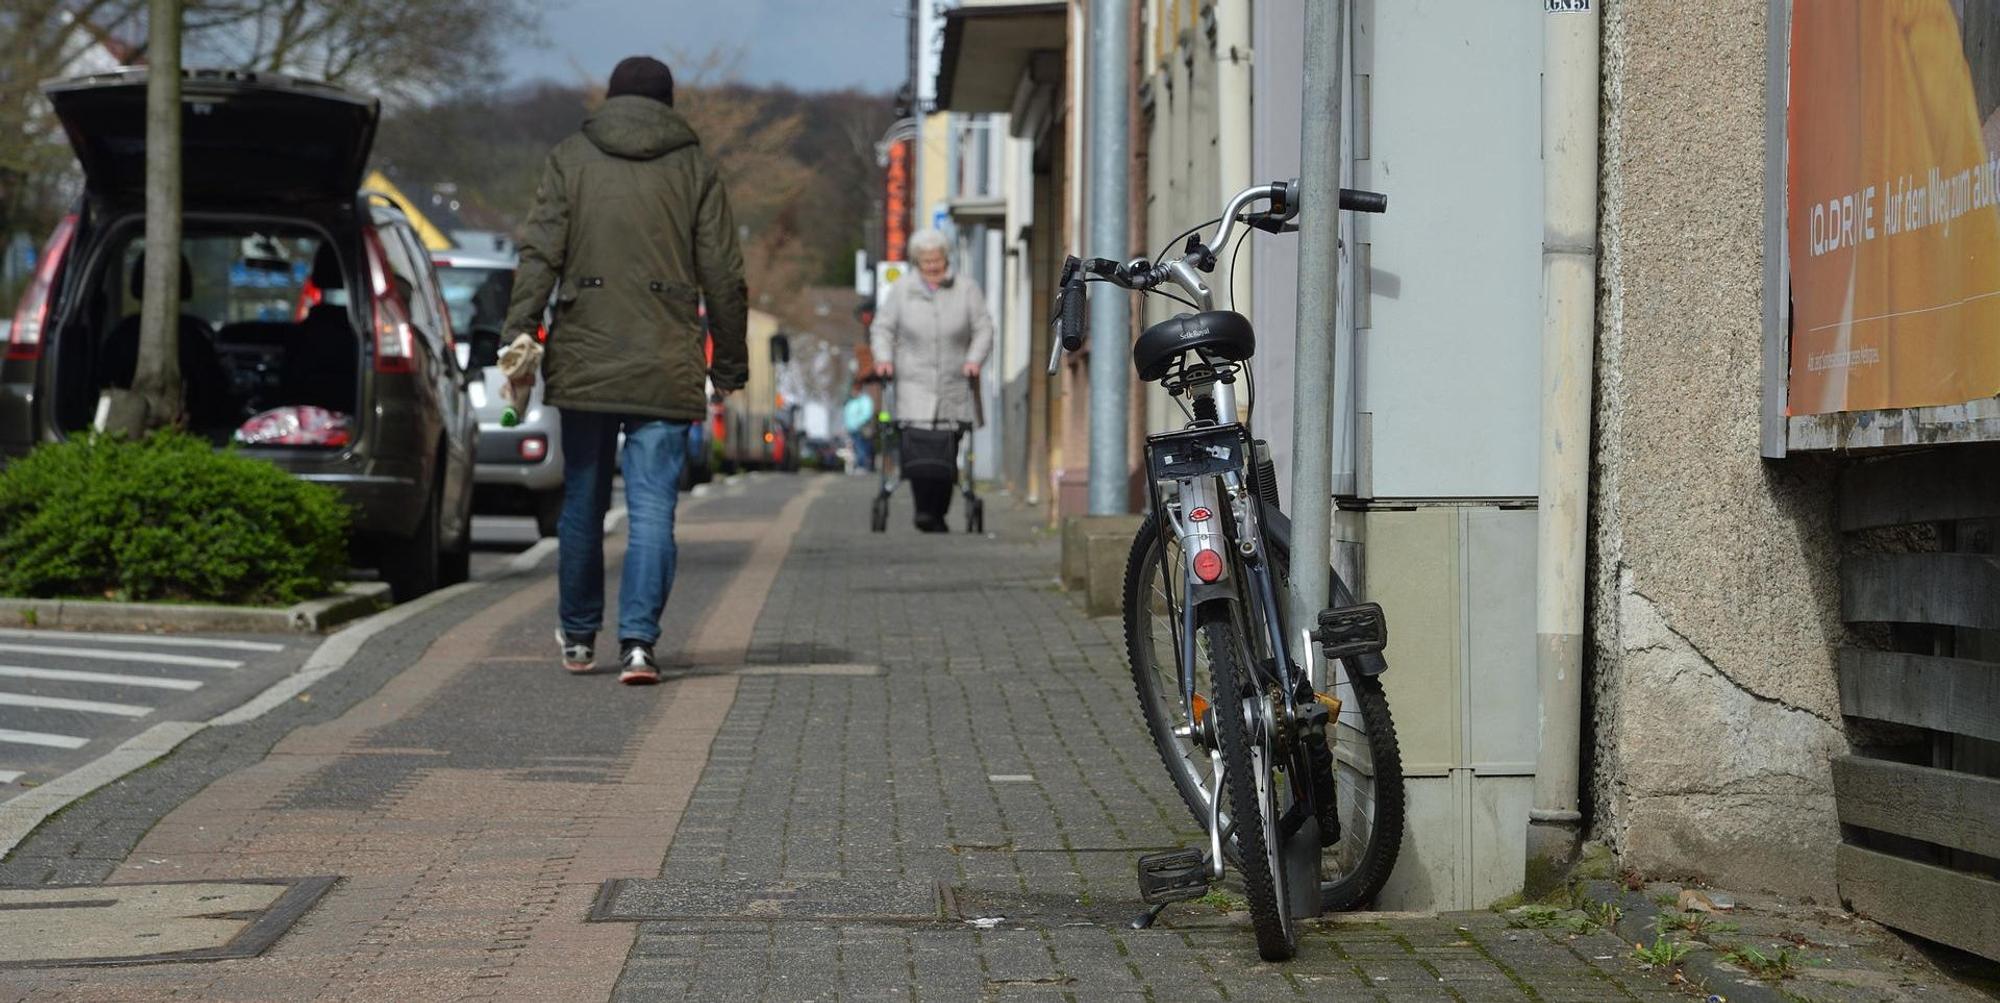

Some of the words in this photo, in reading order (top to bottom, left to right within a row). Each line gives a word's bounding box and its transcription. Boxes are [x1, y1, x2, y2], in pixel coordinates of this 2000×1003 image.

[1810, 185, 1875, 257] IQ.DRIVE
[1884, 176, 1904, 237] Auf
[1905, 174, 1927, 232] dem
[1928, 166, 1949, 238] Weg
[1950, 168, 1970, 219] zum
